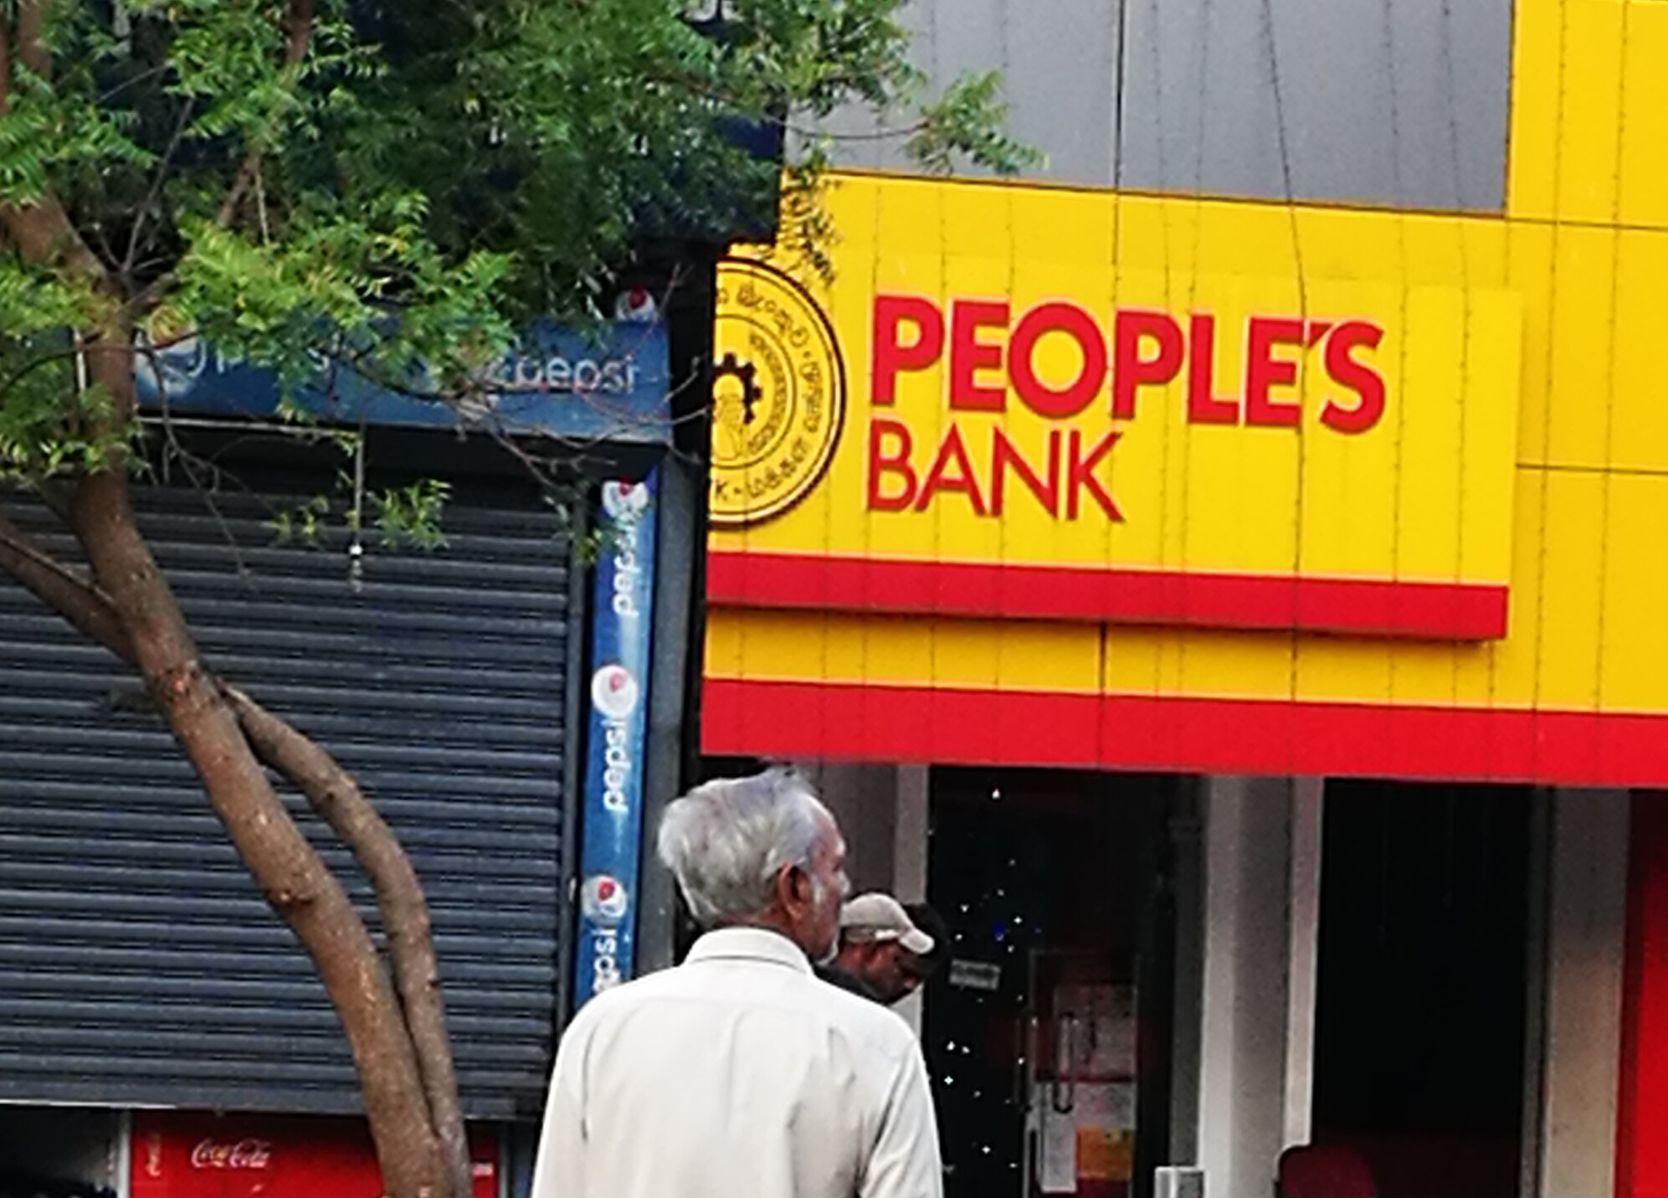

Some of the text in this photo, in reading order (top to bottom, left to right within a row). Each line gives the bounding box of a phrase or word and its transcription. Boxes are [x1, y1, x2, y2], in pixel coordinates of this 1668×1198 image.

[870, 294, 1386, 436] PEOPLE'S
[866, 417, 1125, 523] BANK
[603, 720, 631, 813] pepsi
